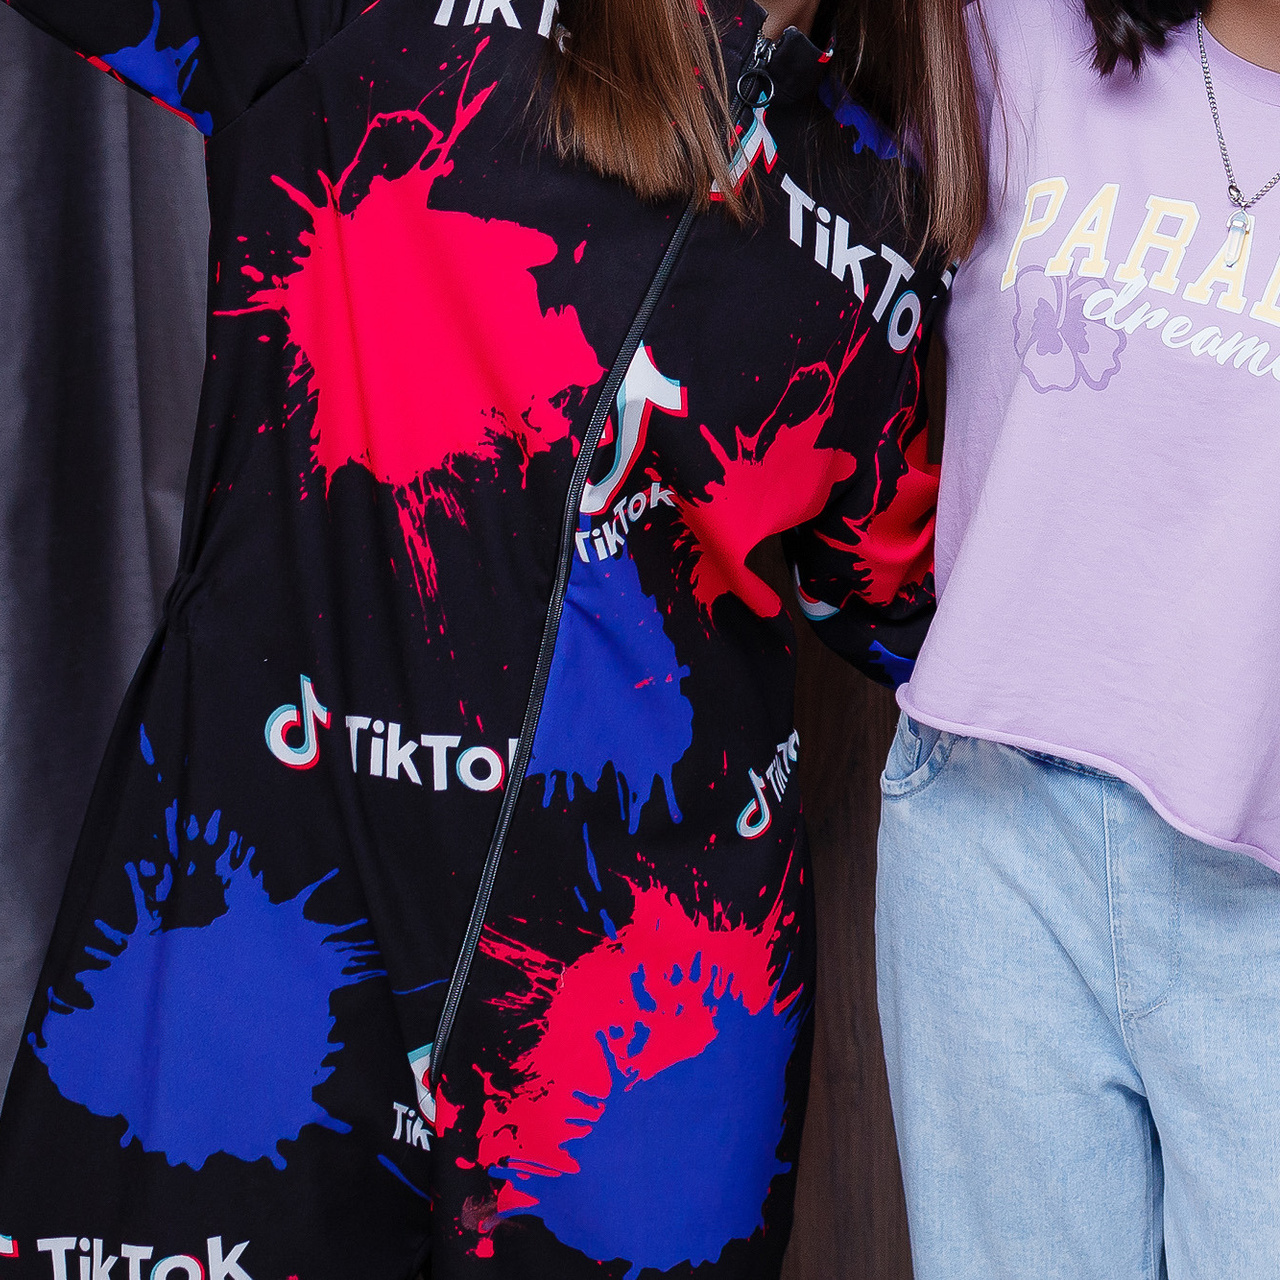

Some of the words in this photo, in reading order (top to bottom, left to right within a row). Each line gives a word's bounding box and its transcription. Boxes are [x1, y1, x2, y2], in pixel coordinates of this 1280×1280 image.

[780, 173, 922, 354] TikTo
[574, 482, 676, 563] TikTok
[345, 715, 519, 792] TikTo
